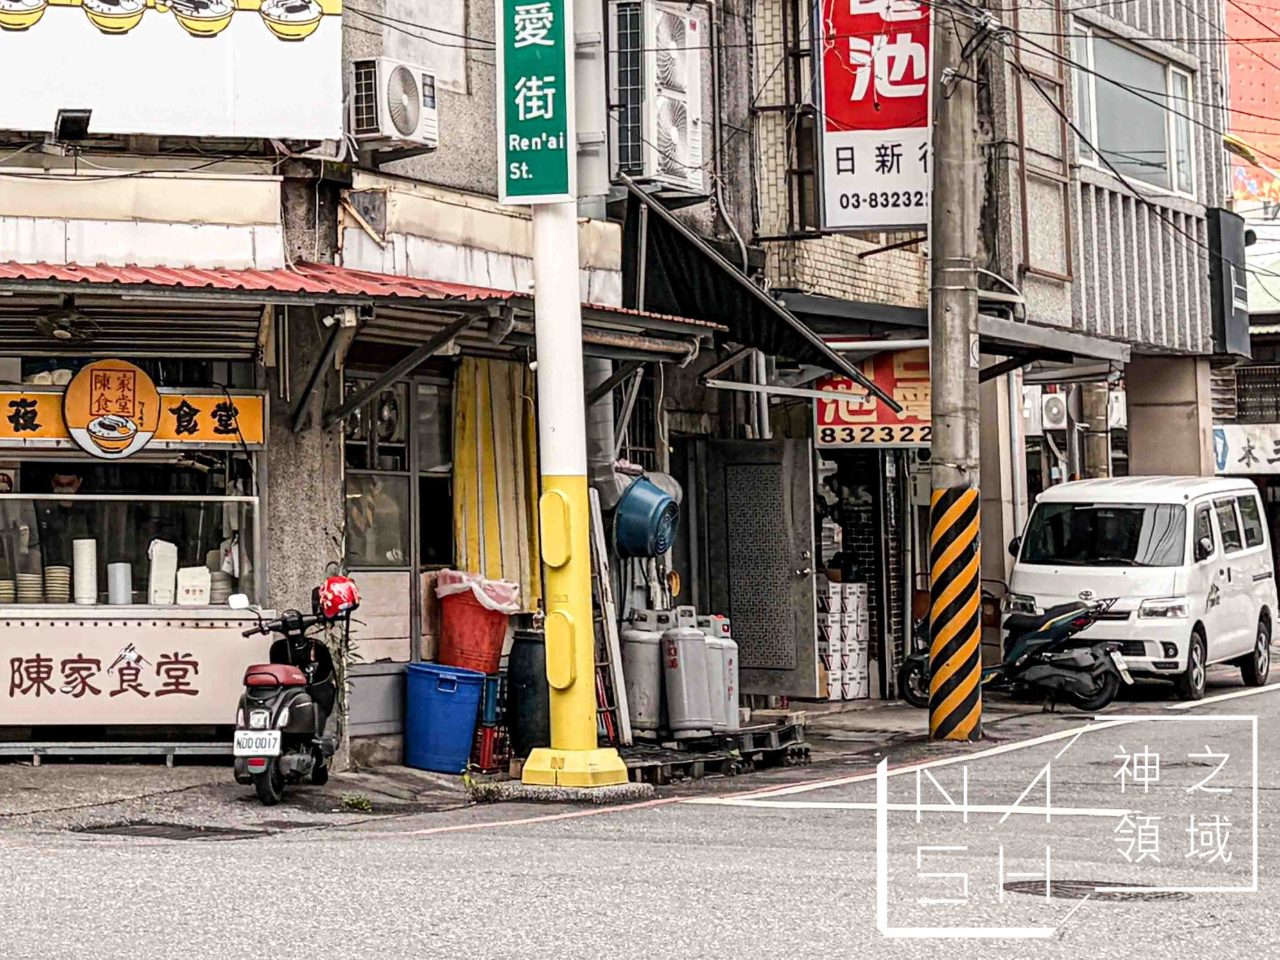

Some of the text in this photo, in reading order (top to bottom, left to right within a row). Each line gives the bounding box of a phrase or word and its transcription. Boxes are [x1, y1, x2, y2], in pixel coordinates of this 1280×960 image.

[508, 132, 564, 151] Ren'ai
[509, 163, 533, 180] St.
[840, 191, 928, 209] 03-83232
[94, 392, 132, 413] 食堂
[168, 400, 239, 436] 食堂
[9, 645, 199, 698] 陳家食堂
